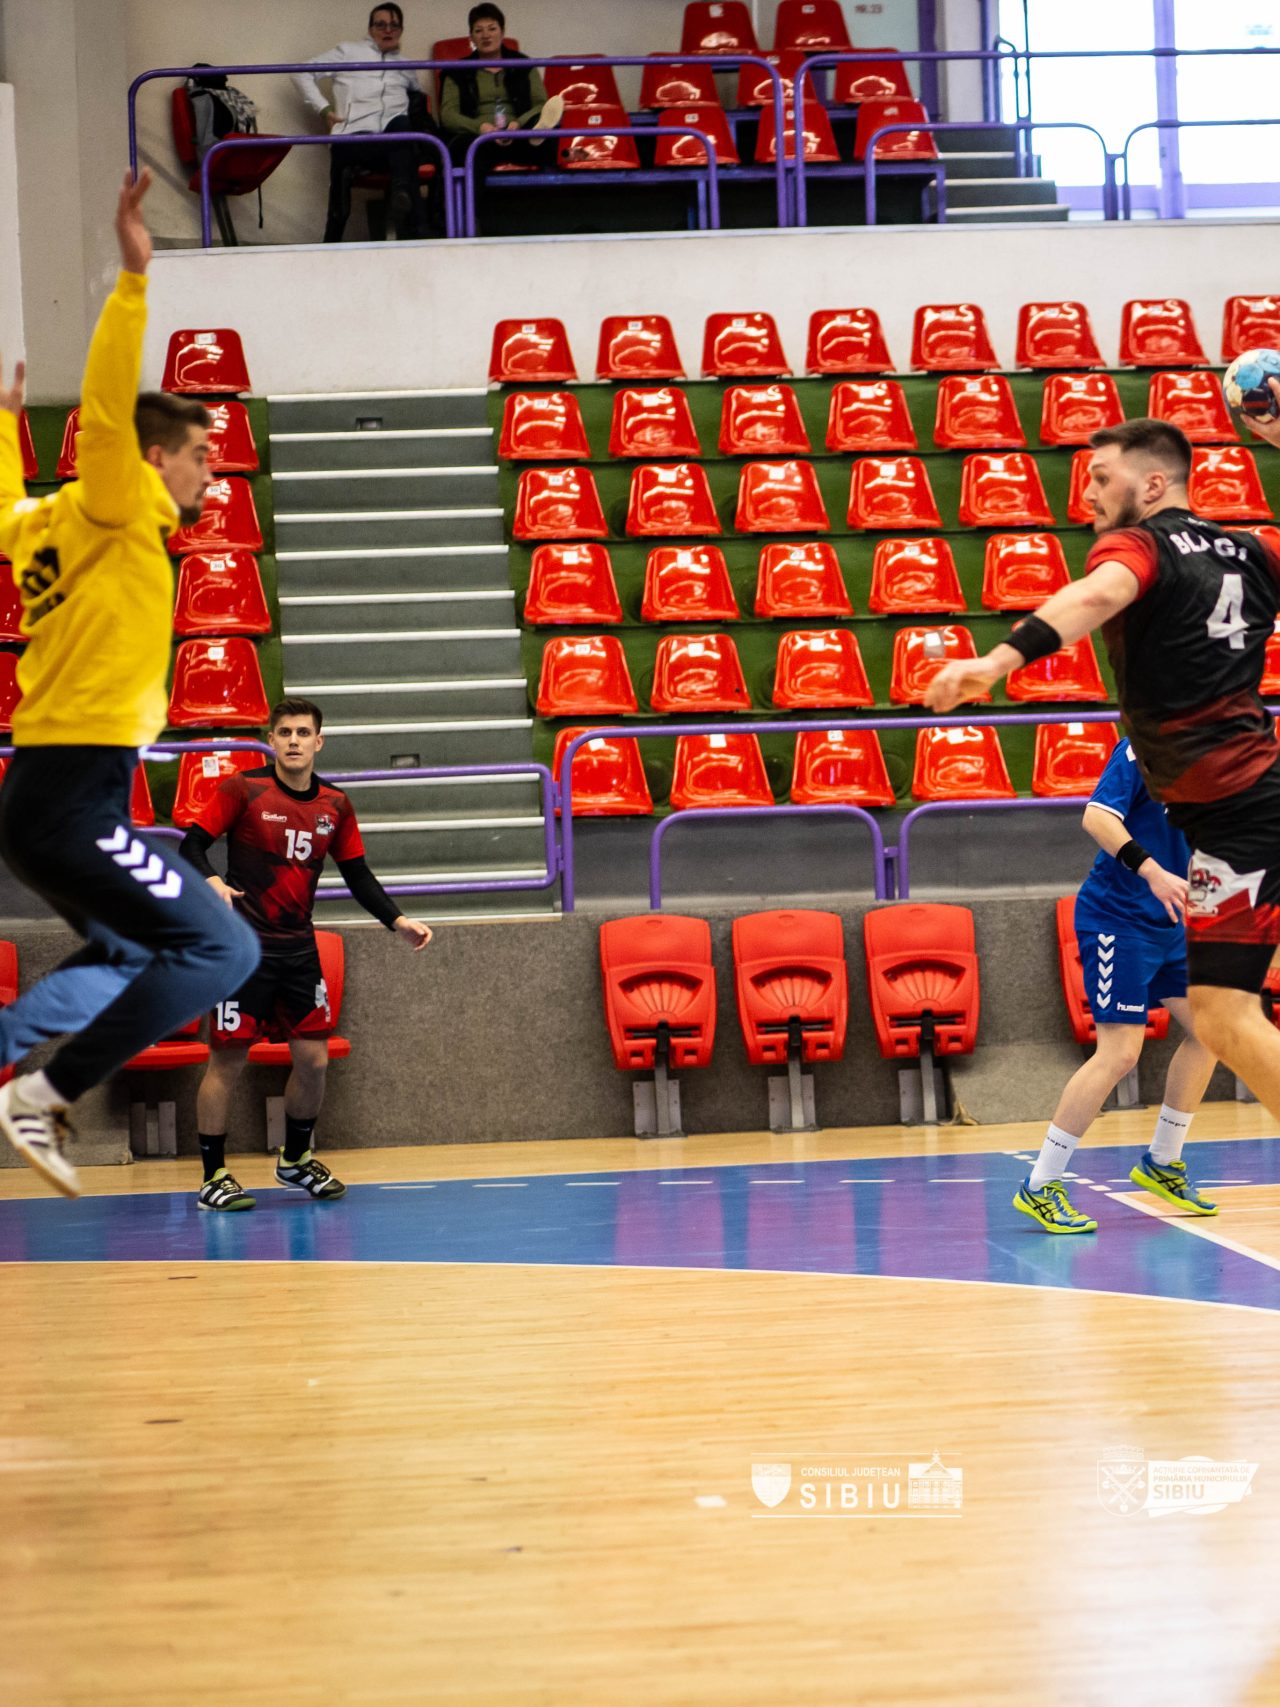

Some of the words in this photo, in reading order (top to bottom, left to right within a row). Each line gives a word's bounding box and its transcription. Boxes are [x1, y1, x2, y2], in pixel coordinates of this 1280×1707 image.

[1206, 573, 1250, 649] 4
[285, 829, 312, 861] 15
[216, 1001, 241, 1032] 15
